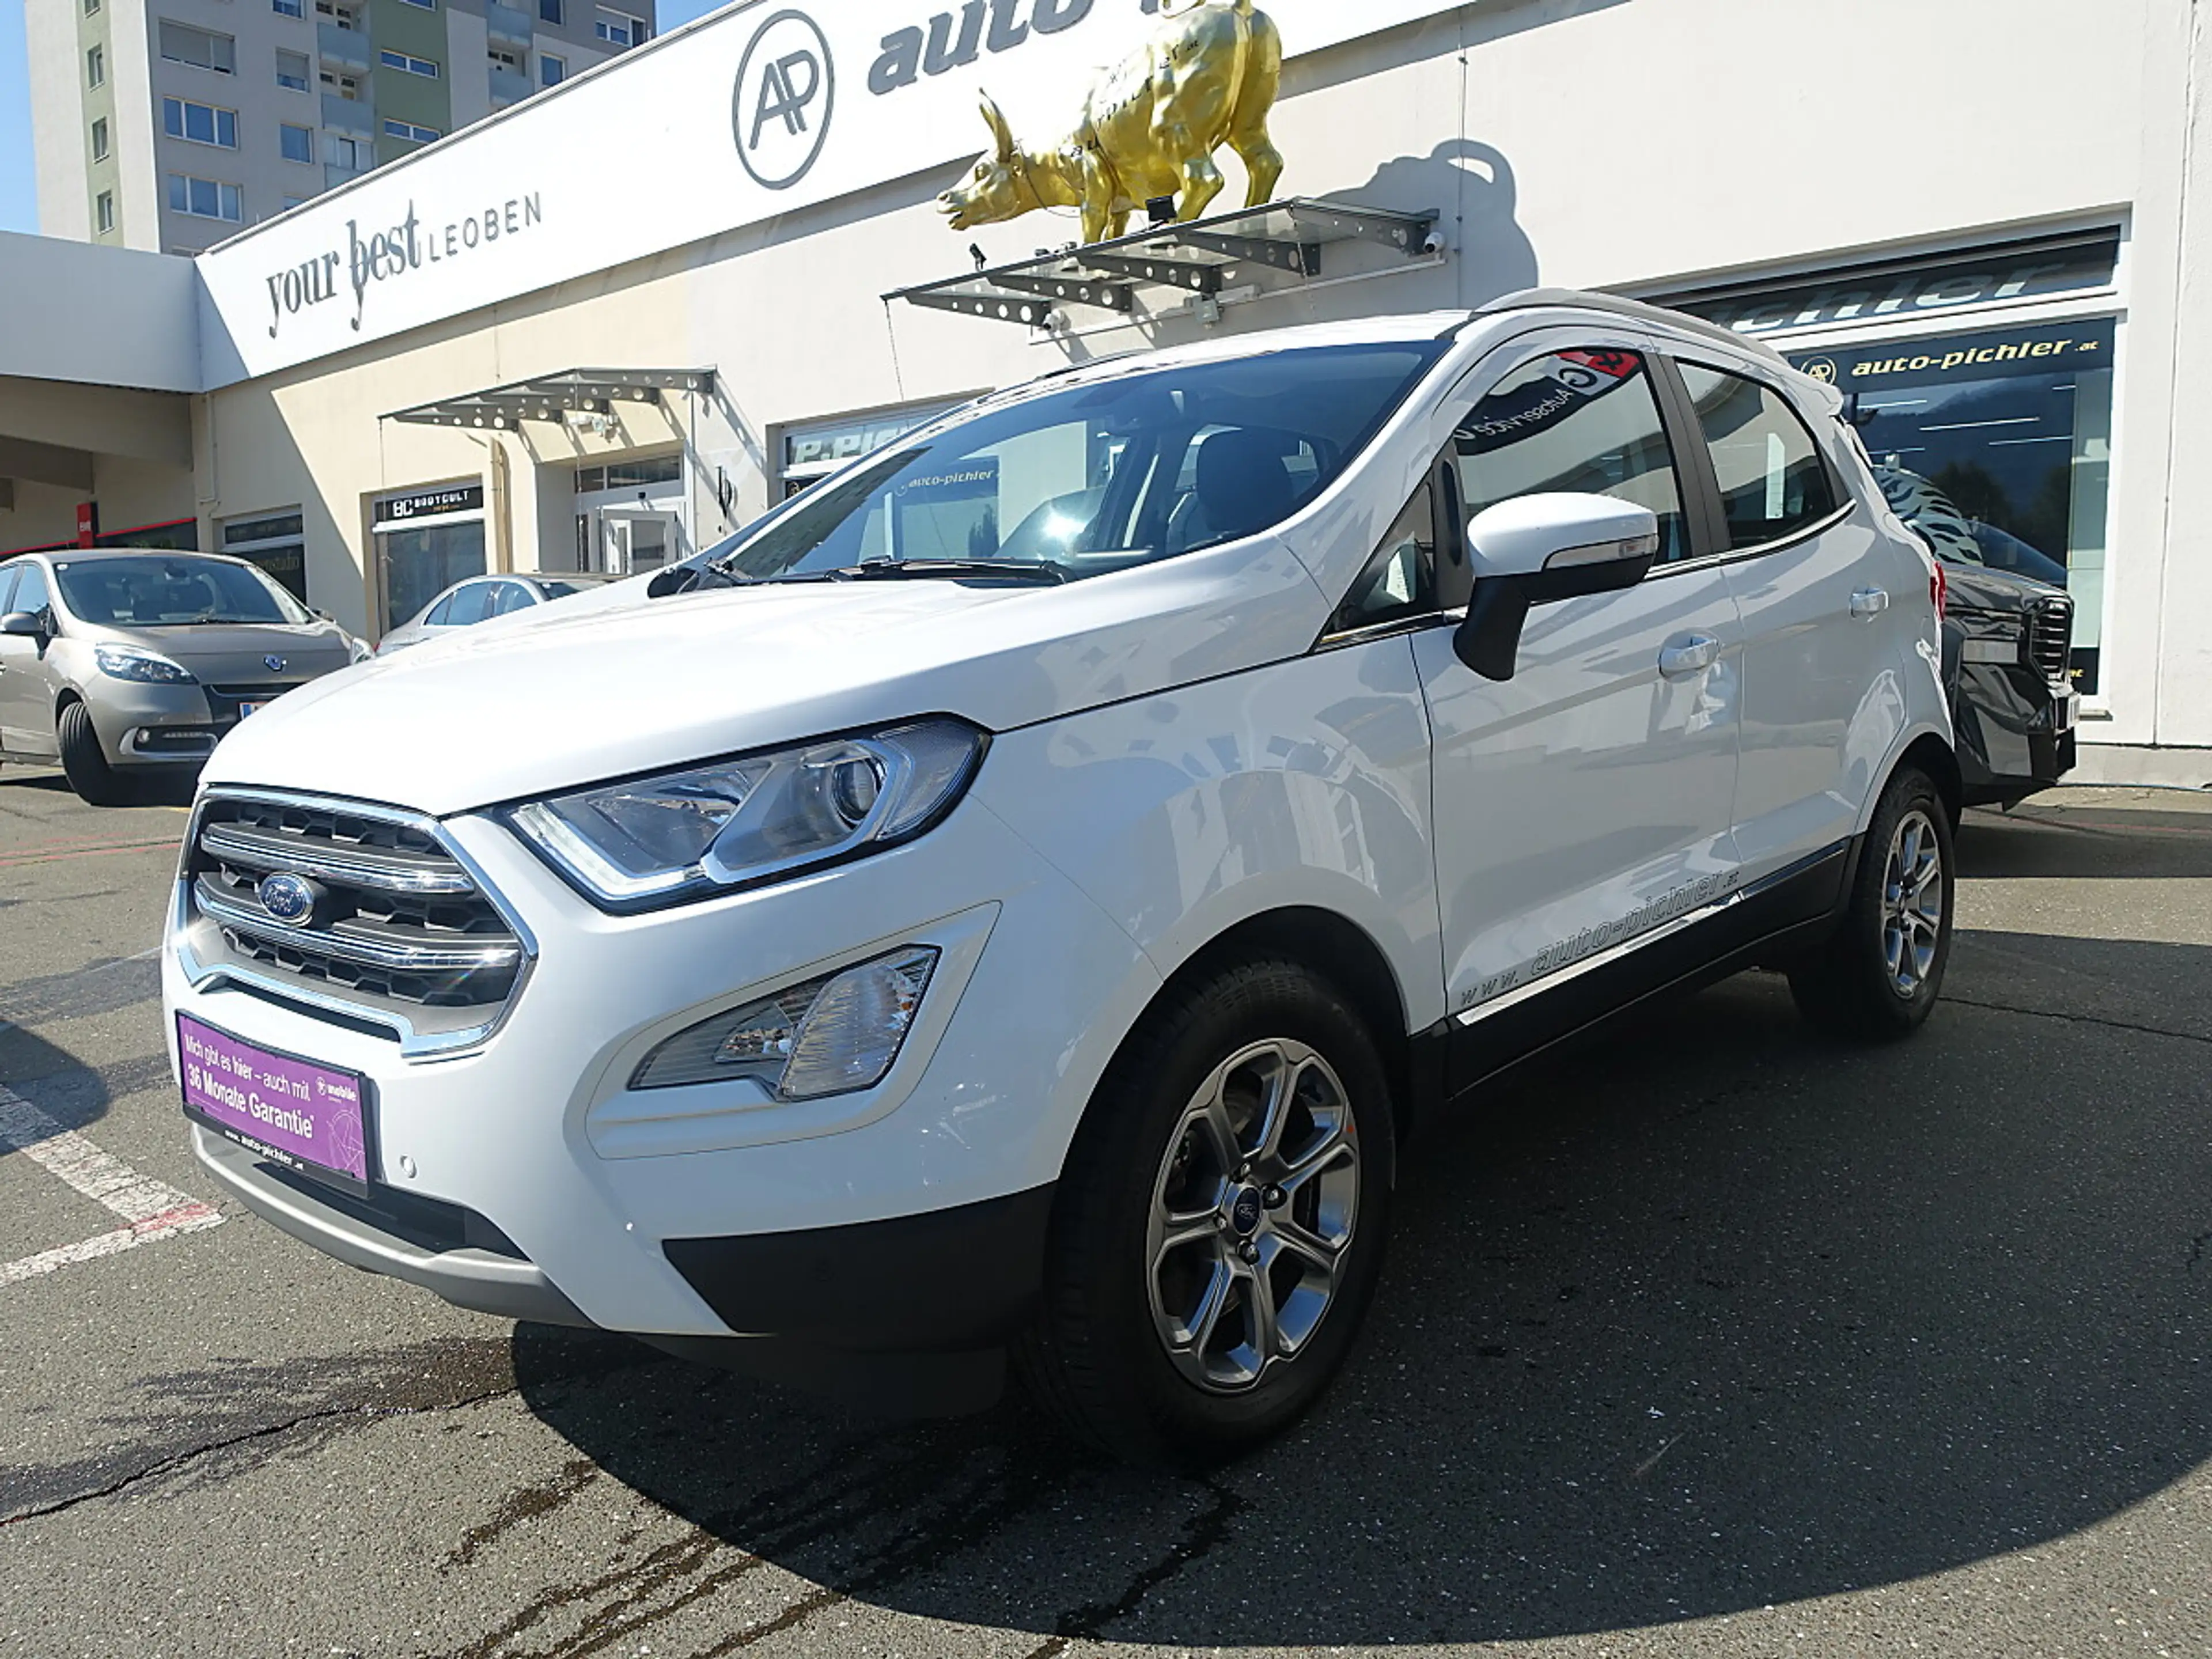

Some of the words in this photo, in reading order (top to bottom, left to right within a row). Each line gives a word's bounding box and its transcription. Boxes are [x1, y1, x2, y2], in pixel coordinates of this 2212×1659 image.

[266, 250, 340, 339] your
[345, 198, 422, 332] best
[429, 191, 541, 262] LEOBEN
[1850, 339, 2074, 376] auto-pichler
[392, 498, 414, 517] BC
[1460, 970, 1519, 1007] www.
[1529, 870, 1723, 977] auto-pichler
[184, 1034, 203, 1059] Mich
[204, 1044, 220, 1067] gibt
[221, 1054, 232, 1072] es
[232, 1055, 253, 1081] hier
[263, 1072, 290, 1094] auch
[291, 1080, 310, 1102] mit
[188, 1063, 202, 1090] 36
[202, 1069, 247, 1113] Monate
